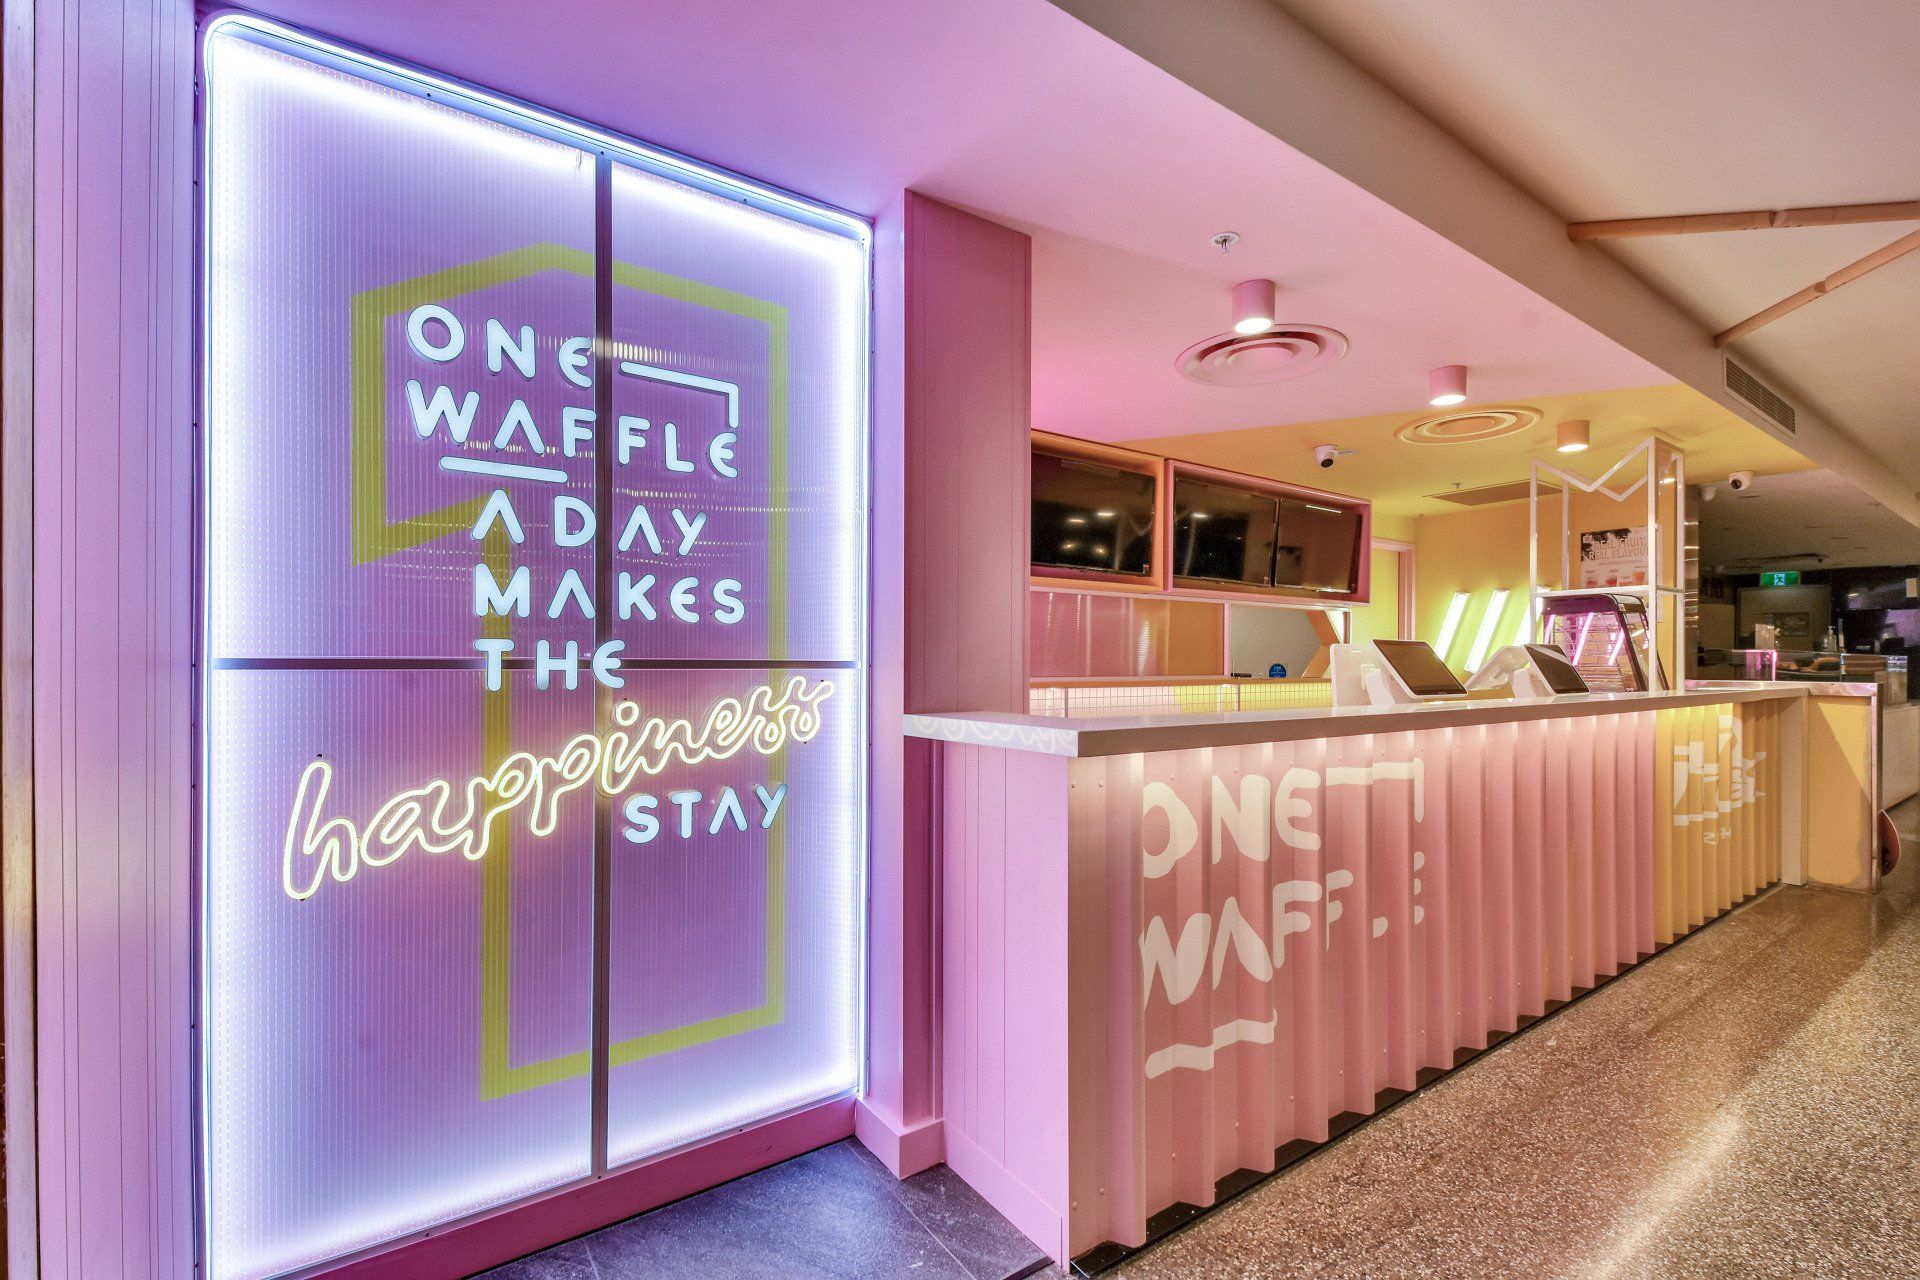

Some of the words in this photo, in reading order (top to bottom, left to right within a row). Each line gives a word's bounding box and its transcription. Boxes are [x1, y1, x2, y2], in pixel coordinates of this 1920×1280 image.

[407, 304, 593, 388] ONE
[406, 379, 739, 478] WAFFLE
[471, 489, 526, 544] A
[554, 495, 707, 556] DAY
[474, 563, 745, 624] MAKES
[474, 638, 626, 692] THE
[283, 676, 836, 900] happiness
[624, 784, 788, 844] STAY
[1142, 767, 1322, 879] ONE
